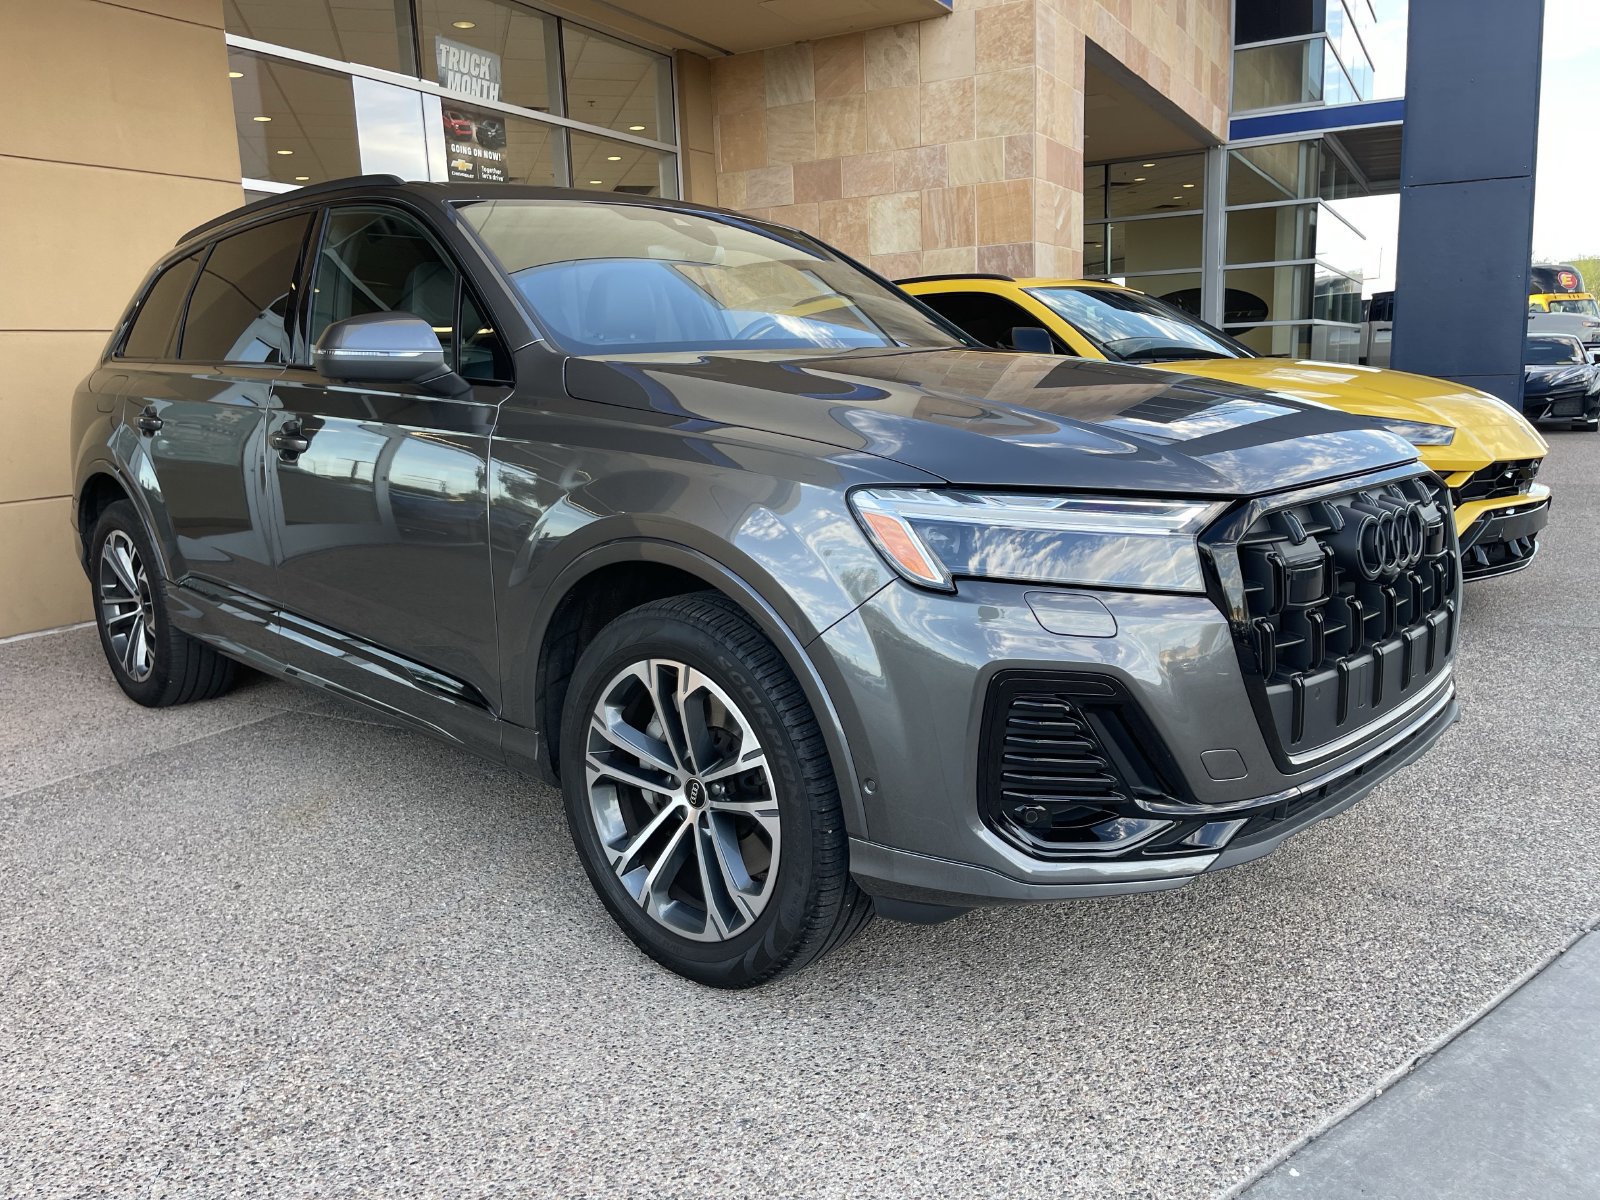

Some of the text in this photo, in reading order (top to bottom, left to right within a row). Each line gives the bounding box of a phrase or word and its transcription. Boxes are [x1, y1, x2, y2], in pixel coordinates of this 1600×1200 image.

[440, 44, 491, 79] TRUCK
[447, 71, 499, 102] MONTH
[451, 144, 502, 161] GOING ON NOW!
[714, 655, 800, 801] SCORPION
